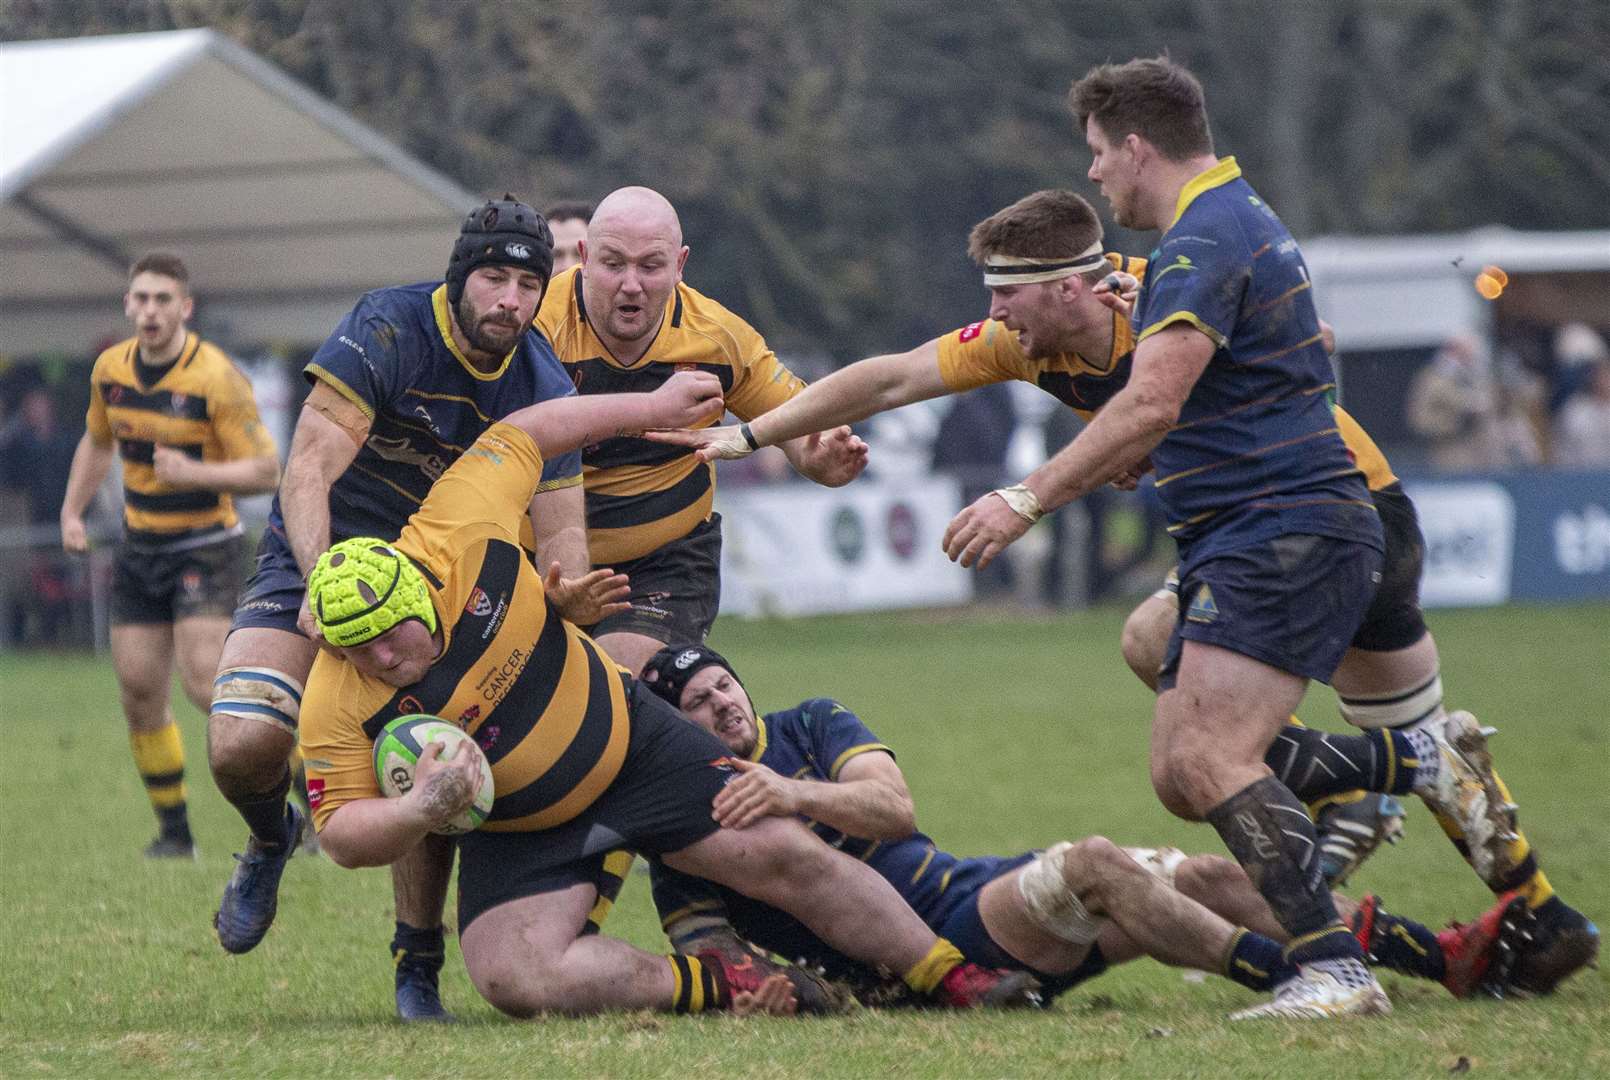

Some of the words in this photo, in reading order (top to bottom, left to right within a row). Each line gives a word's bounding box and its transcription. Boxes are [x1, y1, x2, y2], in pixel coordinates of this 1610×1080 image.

[338, 626, 371, 641] RHINO
[481, 598, 506, 639] canterbury
[483, 648, 524, 701] CANCER
